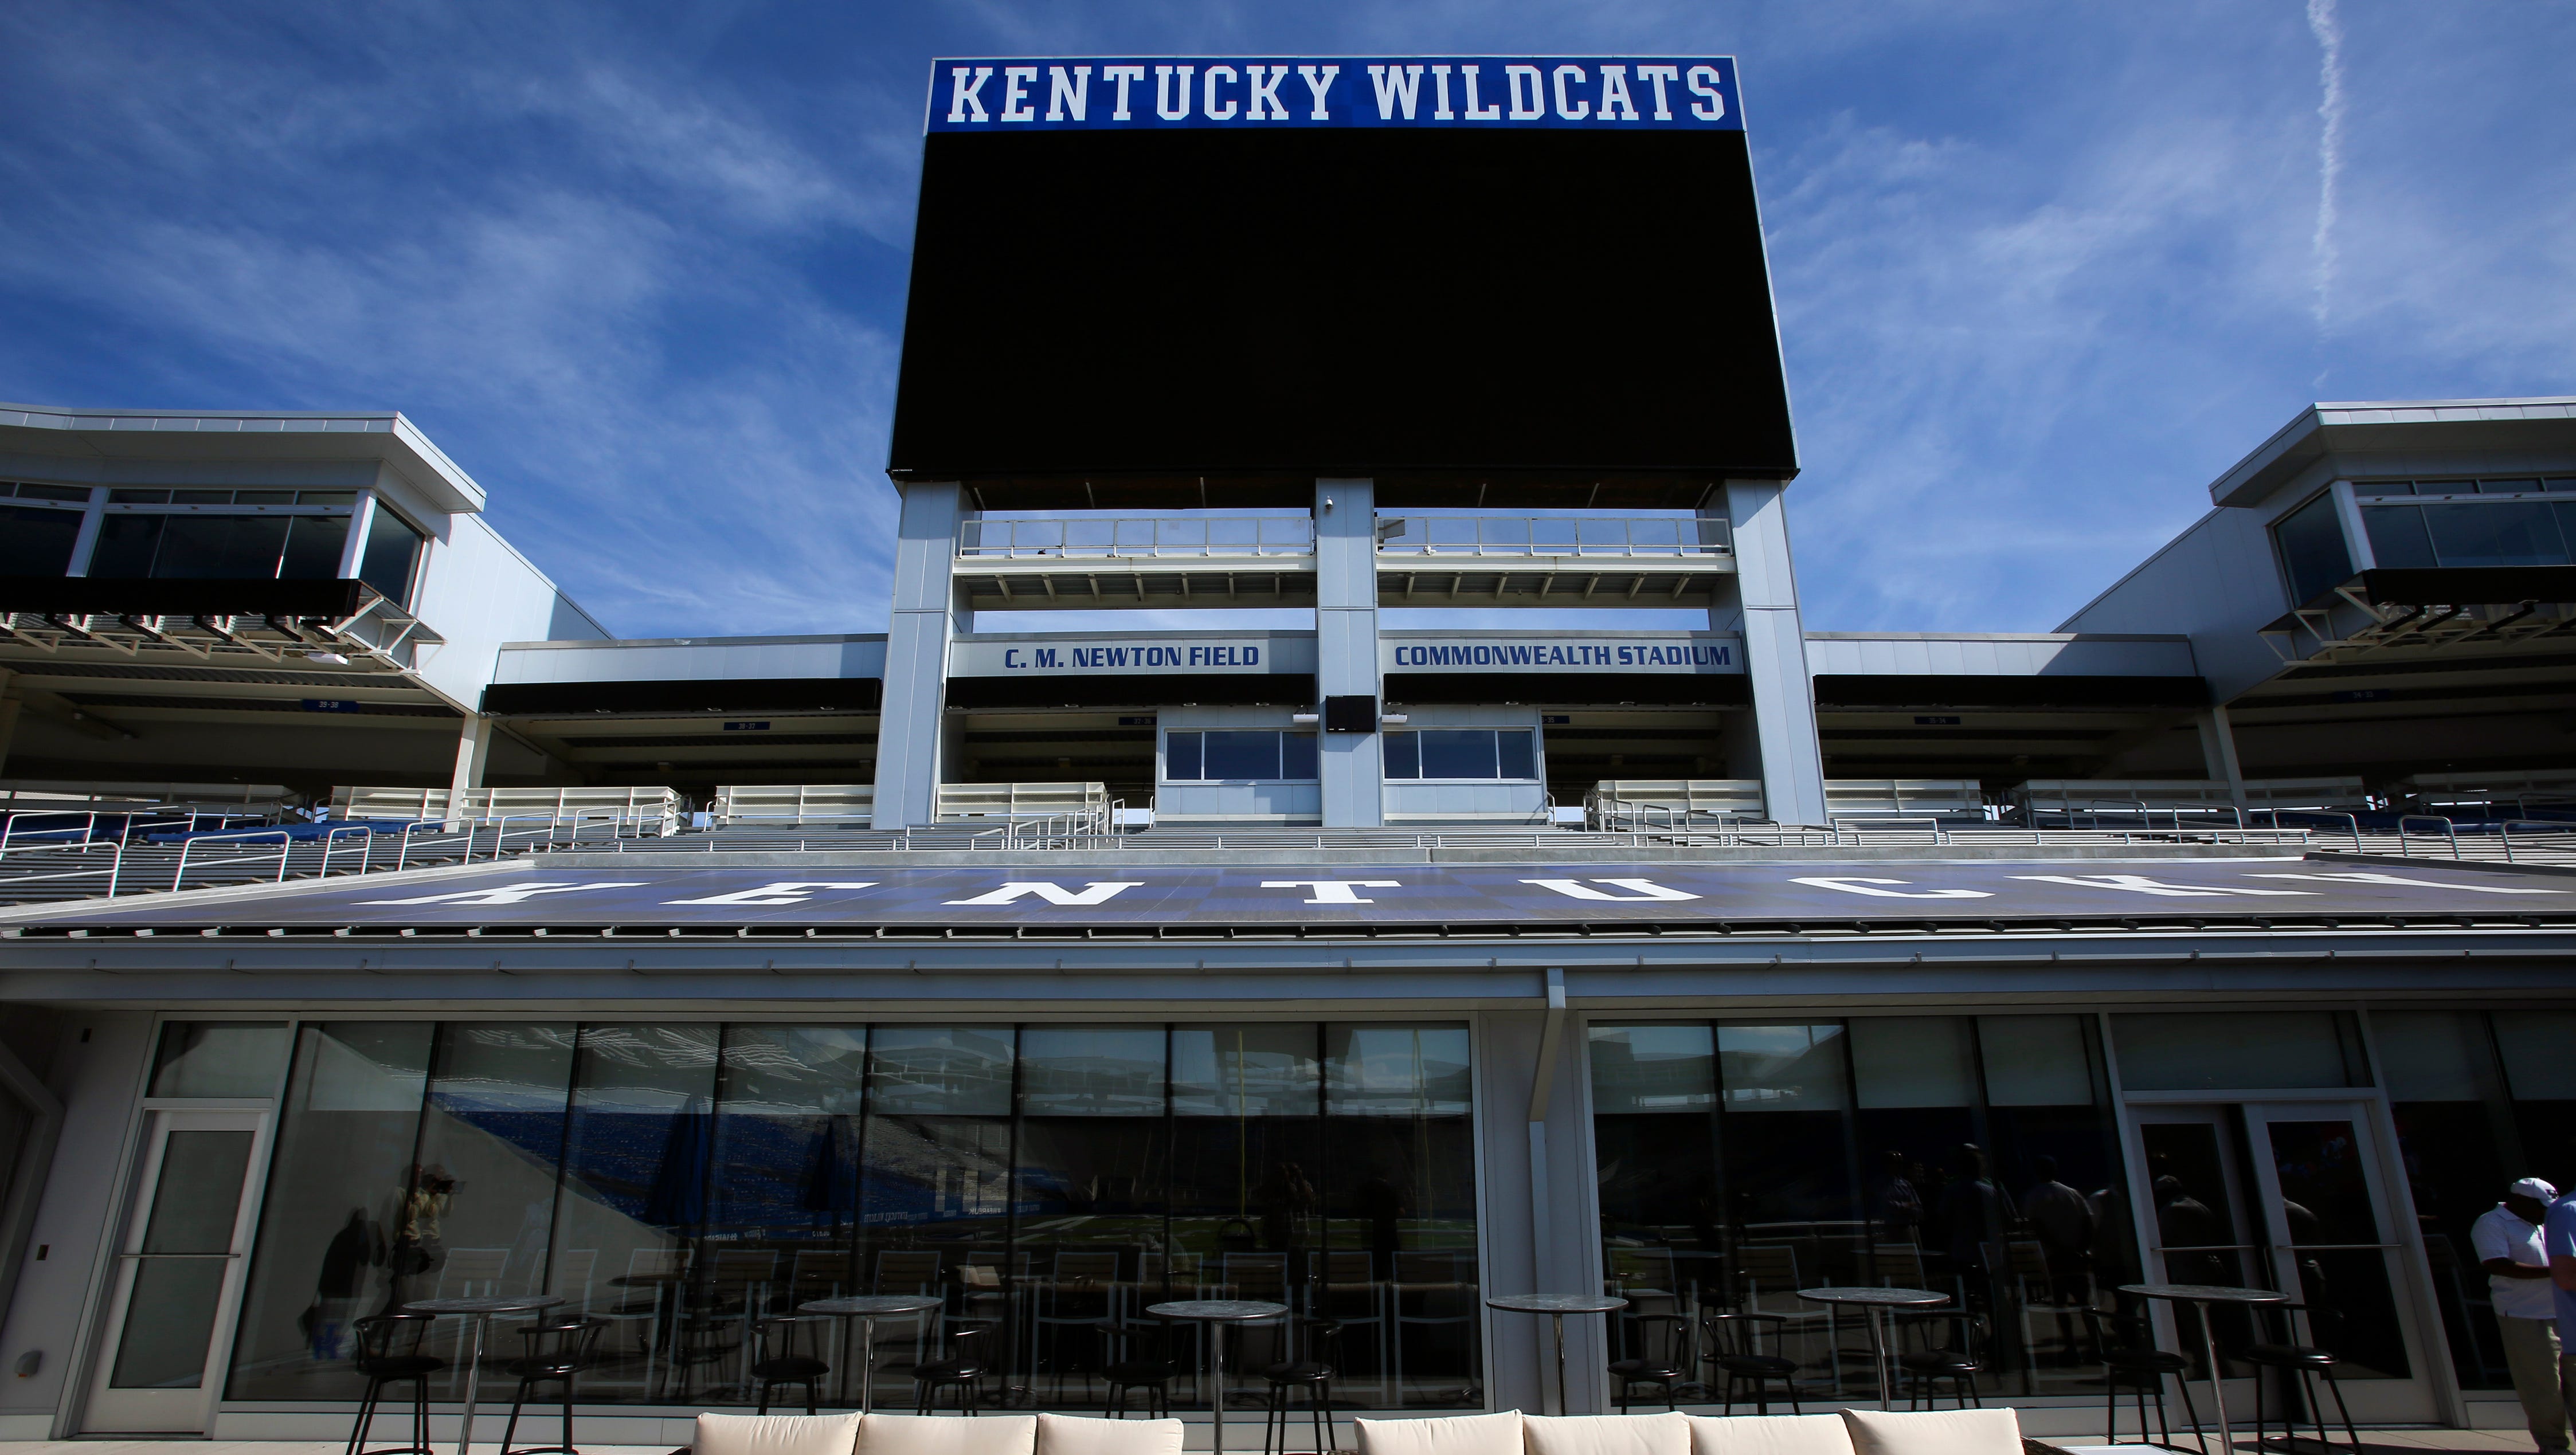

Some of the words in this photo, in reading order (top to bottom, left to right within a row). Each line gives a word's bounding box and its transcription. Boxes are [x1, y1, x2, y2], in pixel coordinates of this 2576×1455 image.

[947, 65, 1340, 123] KENTUCKY
[1367, 65, 1725, 121] WILDCATS
[1005, 649, 1027, 668] C.
[1035, 649, 1064, 668] M.
[1072, 647, 1181, 667] NEWTON
[1189, 646, 1259, 666] FIELD
[1396, 646, 1611, 665] COMMONWEALTH
[1618, 646, 1731, 665] STADIUM
[351, 873, 2574, 905] KENTUCKY
